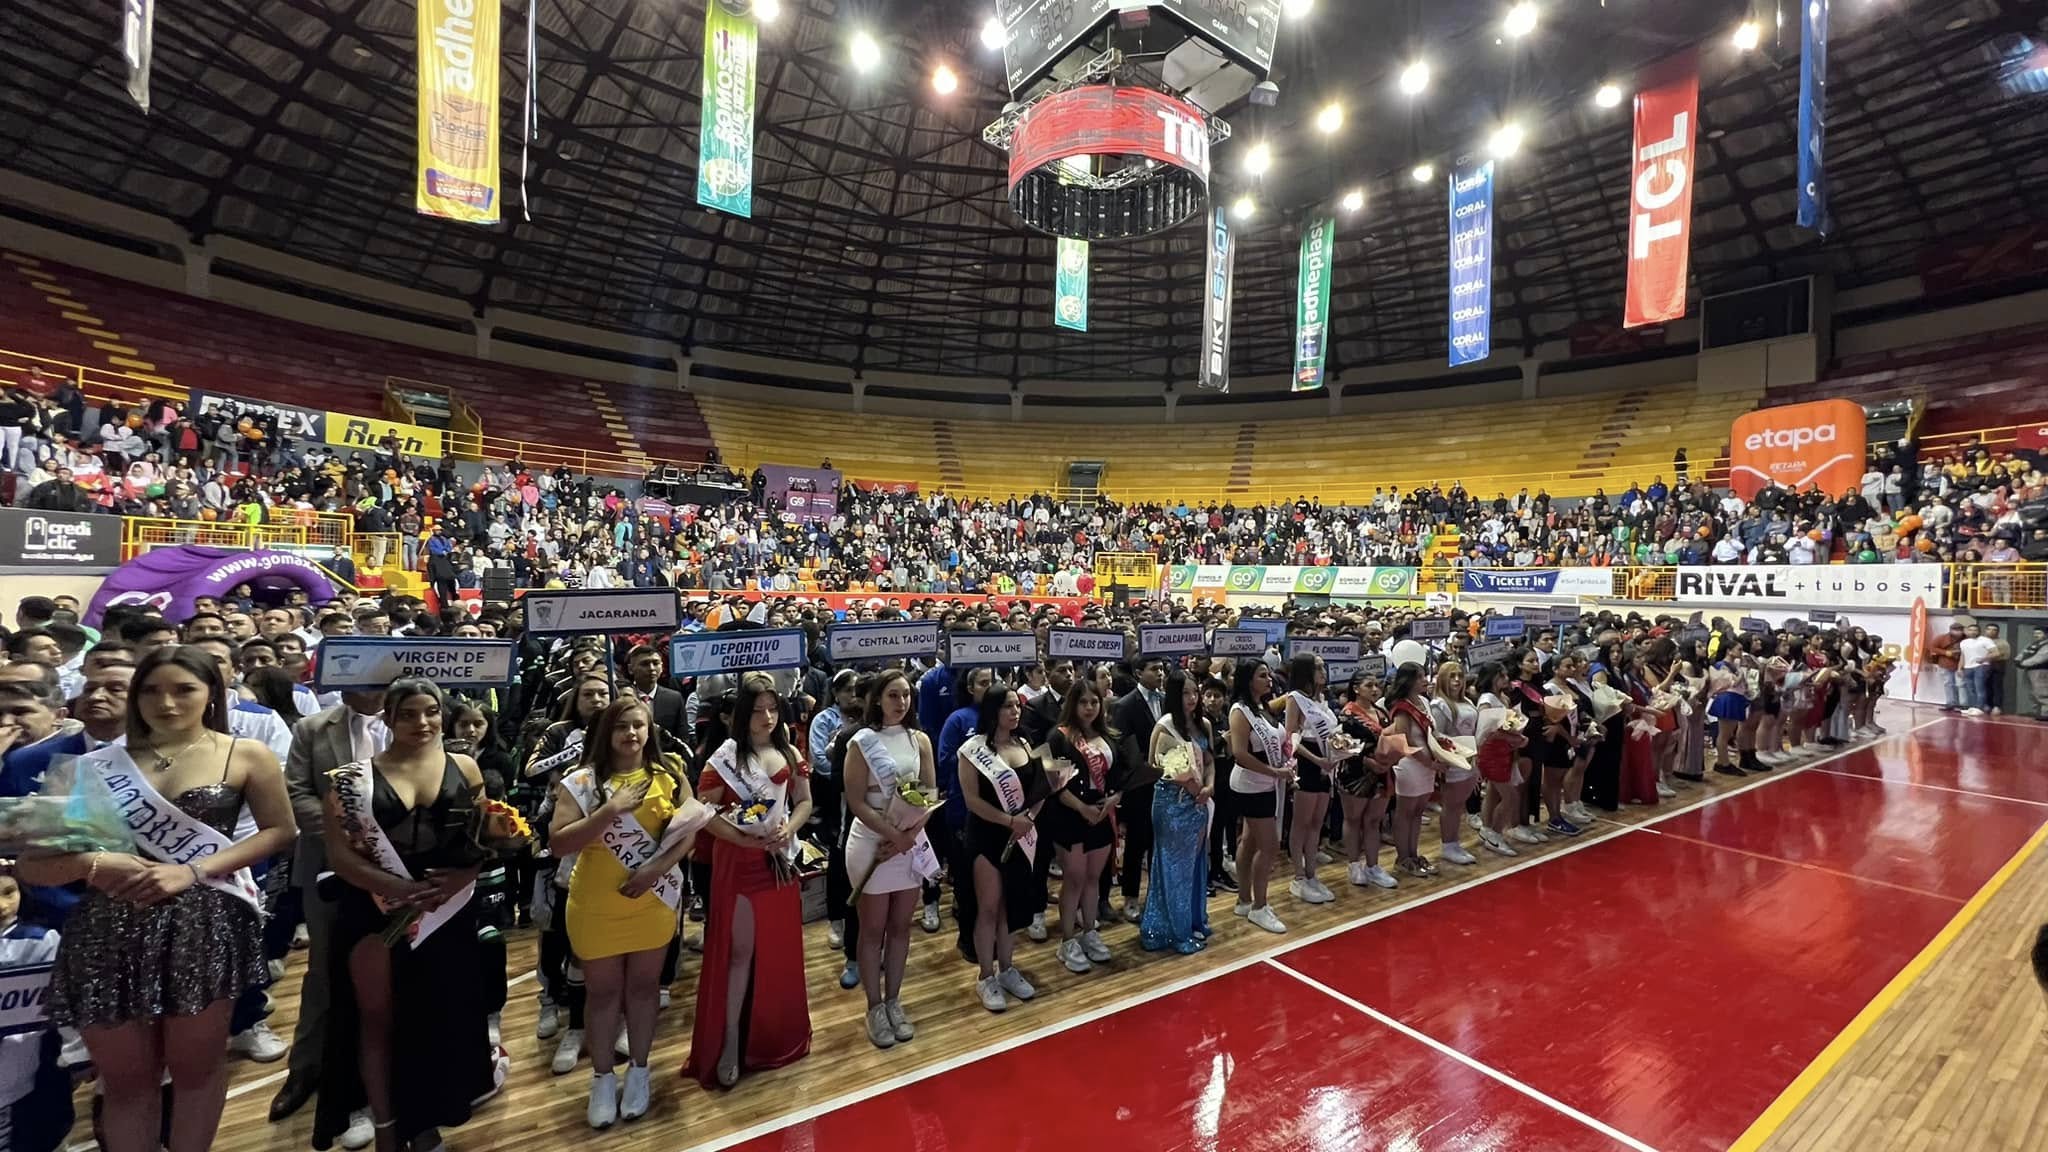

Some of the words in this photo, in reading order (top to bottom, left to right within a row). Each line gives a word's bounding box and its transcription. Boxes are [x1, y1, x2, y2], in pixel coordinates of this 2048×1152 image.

[1456, 176, 1487, 193] CORAL
[1634, 111, 1689, 259] TCL
[1455, 200, 1487, 218] CORAL
[1454, 226, 1487, 243] CORAL
[1454, 252, 1486, 269] CORAL
[1453, 278, 1486, 296] CORAL
[1452, 304, 1486, 321] CORAL
[1211, 297, 1225, 377] BIKE
[1452, 331, 1485, 347] CORAL
[343, 419, 424, 453] Ruh
[1745, 424, 1836, 452] etapa
[48, 521, 91, 536] credi
[47, 534, 77, 550] clic
[1680, 573, 1787, 598] RIVAL
[579, 608, 657, 619] JACARANDA
[710, 639, 780, 657] DEPORTIVO
[858, 635, 900, 648] CENTRAL
[902, 634, 936, 646] TARQUI
[1005, 643, 1022, 653] UNE
[1068, 637, 1096, 649] CARLOS
[1097, 638, 1121, 650] CRESPI
[393, 650, 461, 666] VIRGEN
[464, 650, 486, 664] DE
[721, 652, 770, 668] CUENCA
[402, 664, 474, 679] BRONCE
